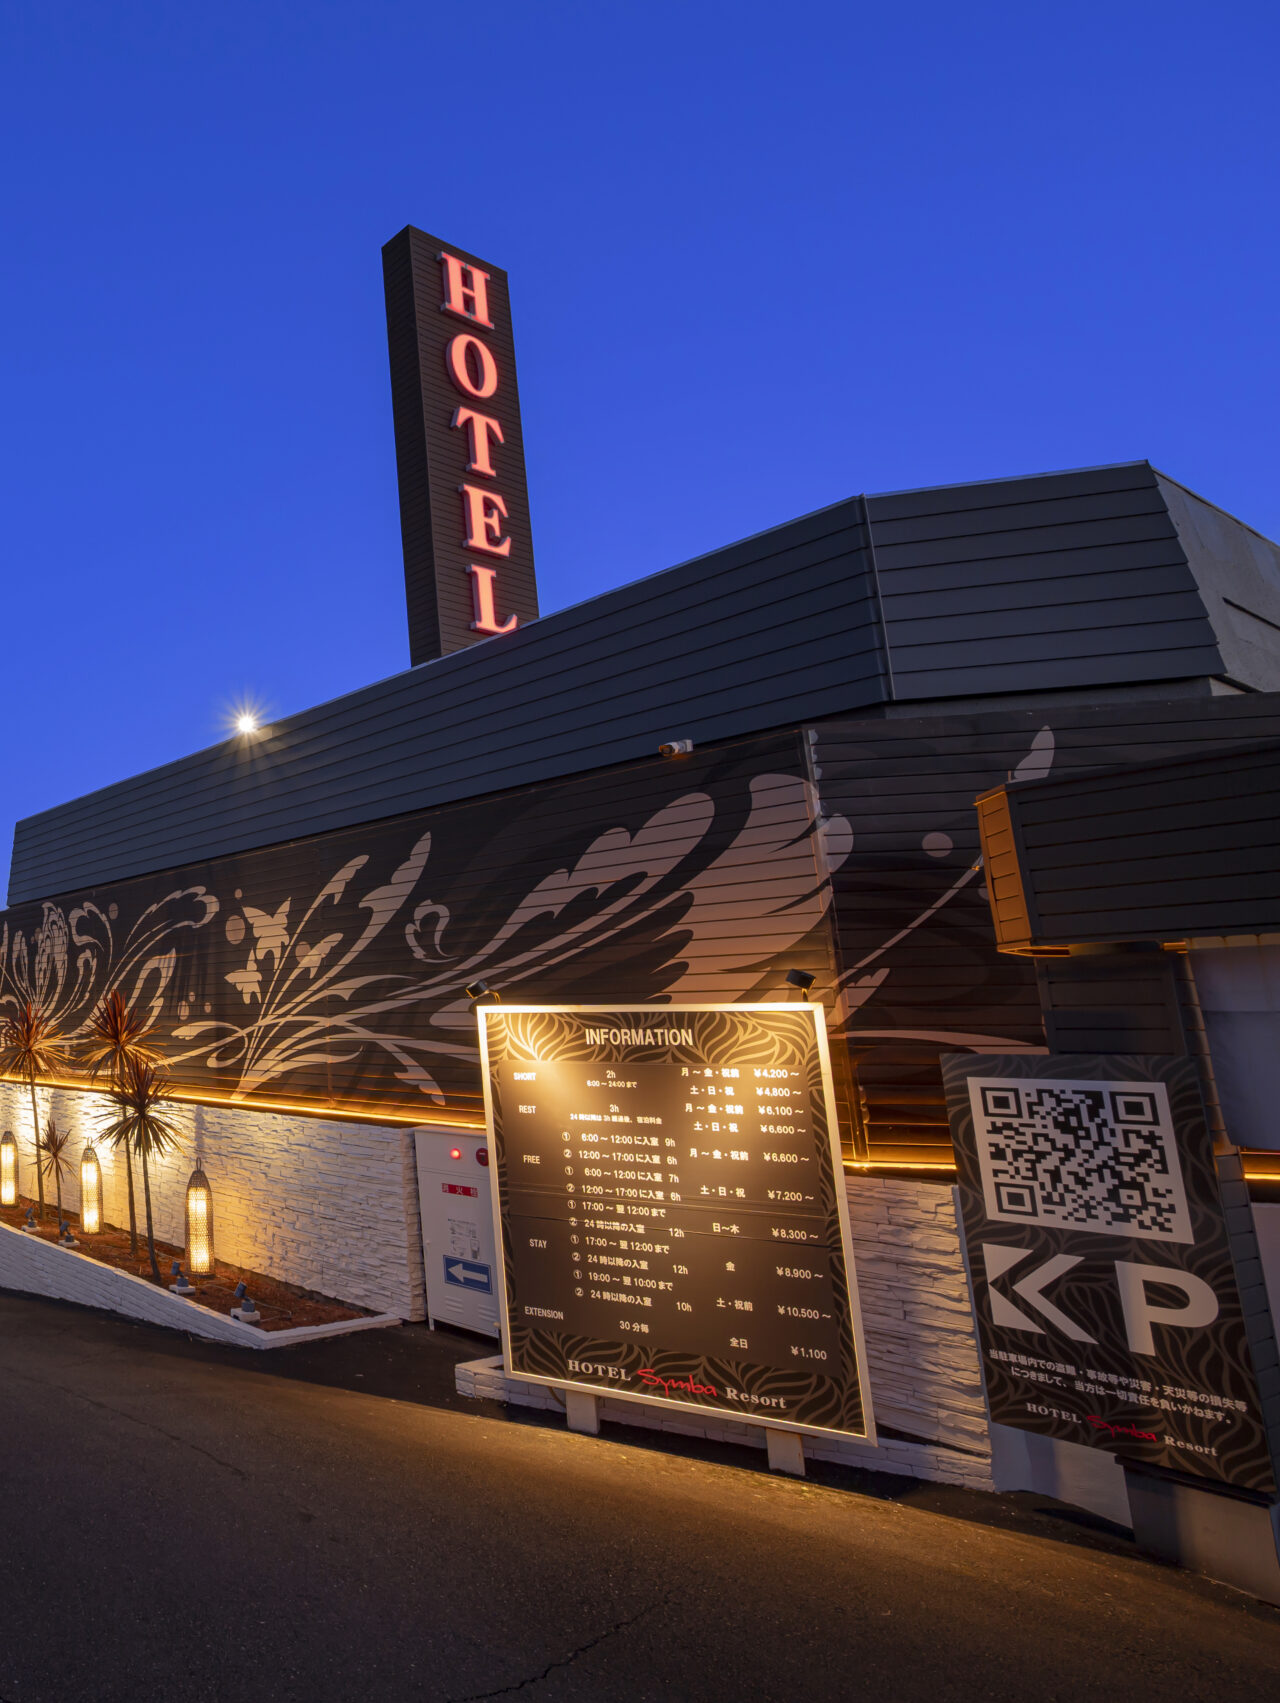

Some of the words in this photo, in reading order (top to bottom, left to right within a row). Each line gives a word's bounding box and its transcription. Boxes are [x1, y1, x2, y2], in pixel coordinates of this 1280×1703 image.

[436, 250, 518, 635] HOTEL
[585, 1028, 694, 1046] INFORMATION
[513, 1072, 536, 1081] SHORT
[606, 1070, 616, 1078] 2h
[518, 1105, 536, 1114] REST
[610, 1104, 620, 1112] 3h
[664, 1138, 676, 1147] 9h
[523, 1155, 540, 1164] FREE
[666, 1156, 678, 1166] 6h
[668, 1174, 680, 1184] 7h
[670, 1192, 681, 1202] 6h
[668, 1228, 685, 1238] 12h
[529, 1238, 547, 1249] STAY
[672, 1264, 688, 1274] 12h
[726, 1261, 736, 1272] 金
[676, 1301, 692, 1312] 10h
[524, 1306, 564, 1320] EXTENSION
[730, 1337, 748, 1350] 全日
[568, 1359, 632, 1381] HOTEL
[636, 1368, 718, 1397] Symba
[725, 1386, 787, 1409] Resort
[1026, 1402, 1082, 1424] HOTEL
[1086, 1415, 1157, 1443] Symba
[1164, 1434, 1218, 1457] Resort
